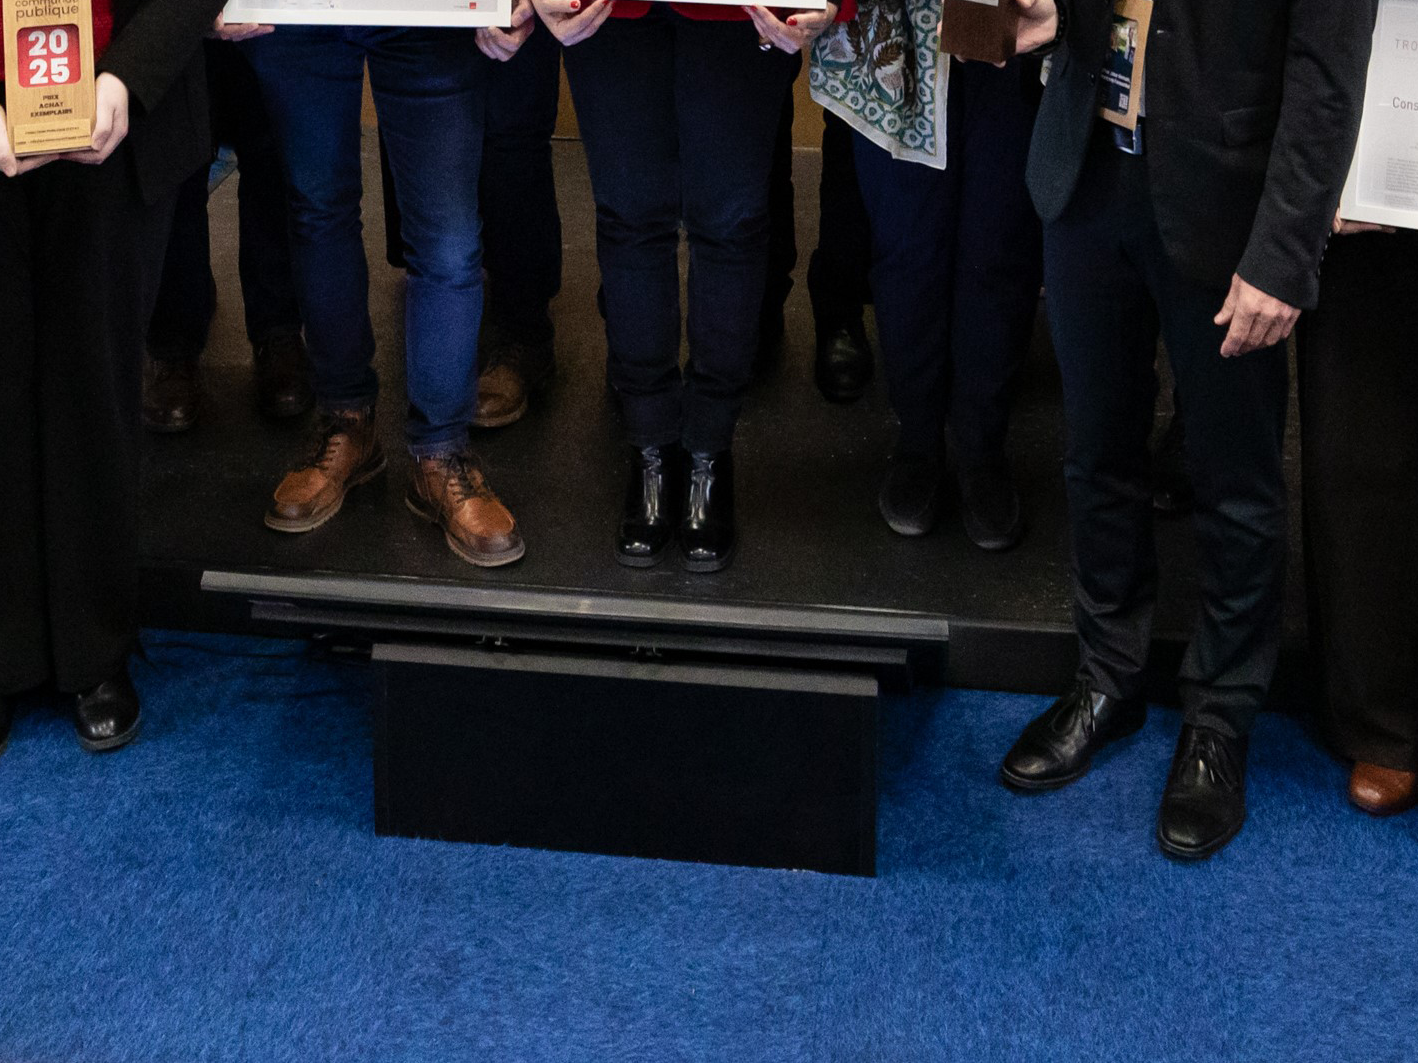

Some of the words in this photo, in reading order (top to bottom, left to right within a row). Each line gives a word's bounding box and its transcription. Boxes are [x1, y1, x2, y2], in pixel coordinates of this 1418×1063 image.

[15, 4, 79, 22] publique
[28, 29, 69, 56] 20
[29, 57, 70, 85] 25
